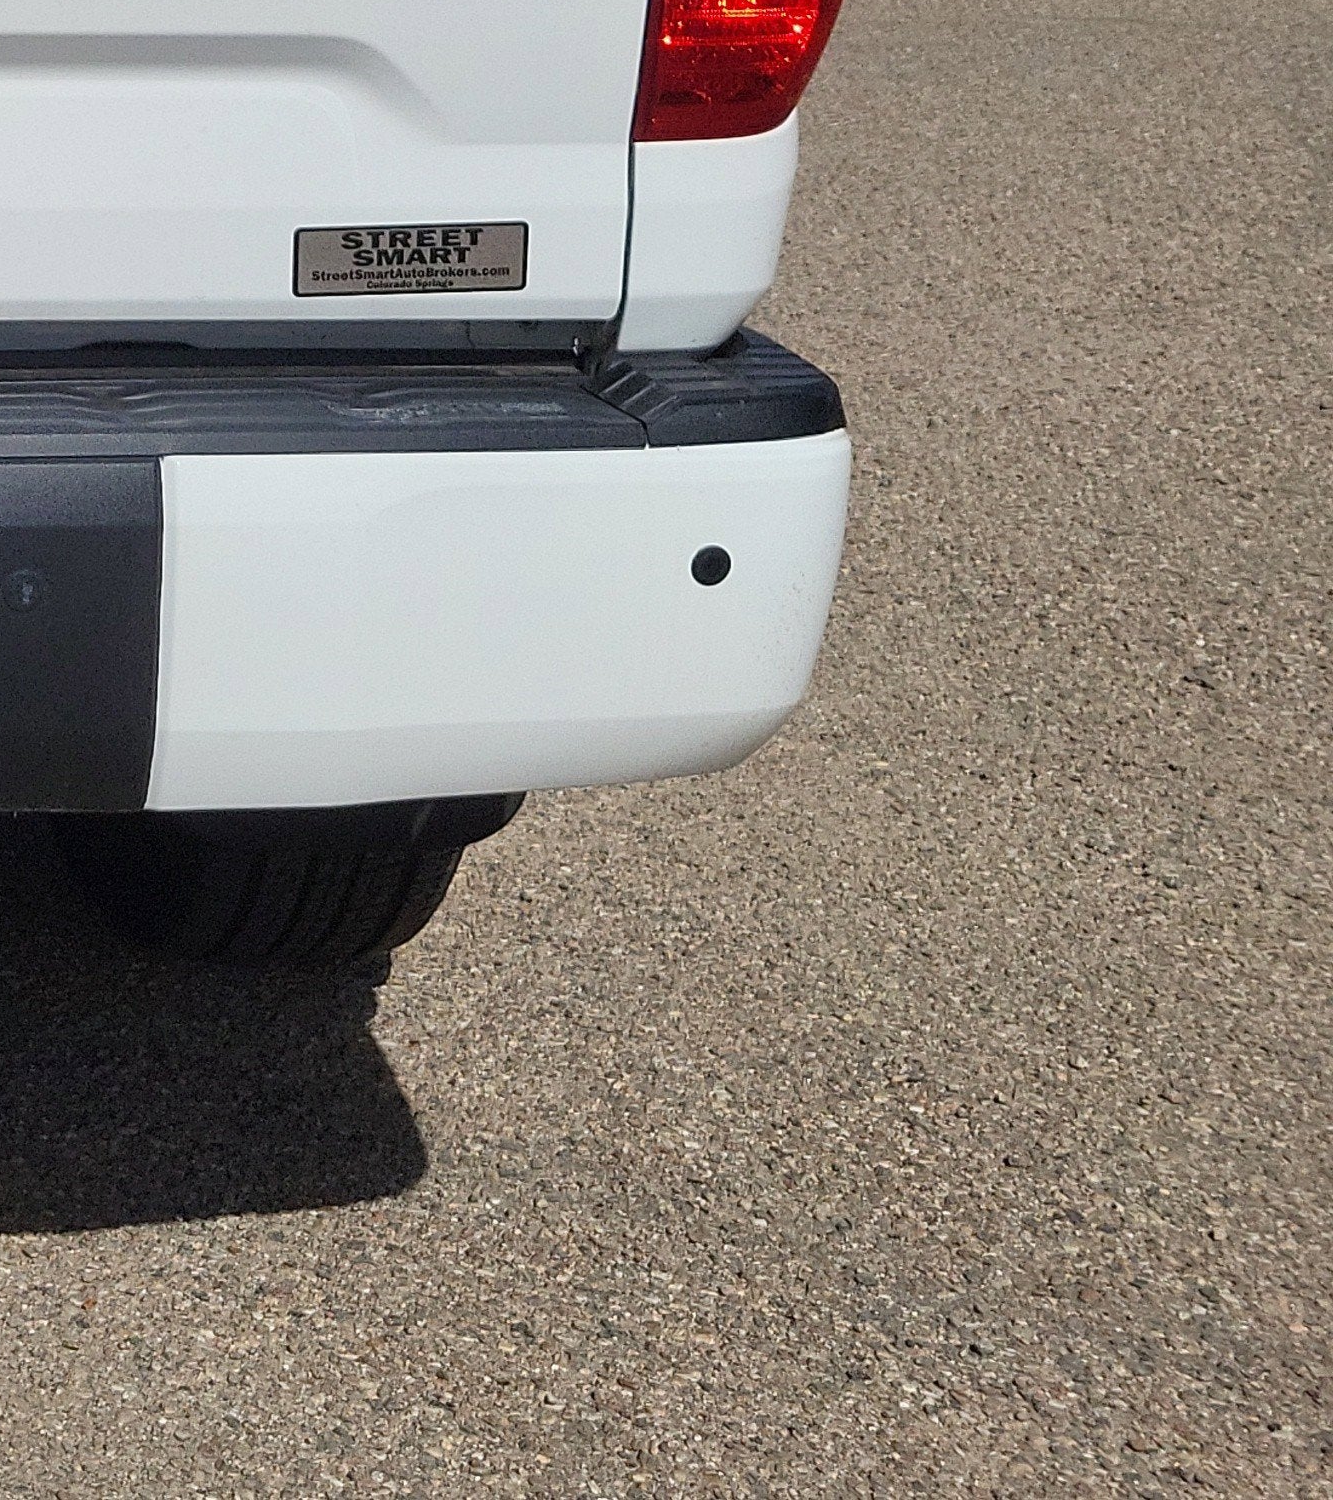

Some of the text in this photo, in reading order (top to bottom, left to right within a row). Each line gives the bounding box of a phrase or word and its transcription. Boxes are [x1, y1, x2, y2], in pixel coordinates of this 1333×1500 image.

[340, 227, 484, 250] STREET
[352, 247, 471, 267] SMART
[311, 266, 511, 282] StreetSmartAutoBrokers.com
[366, 279, 455, 290] Colorado Springs
